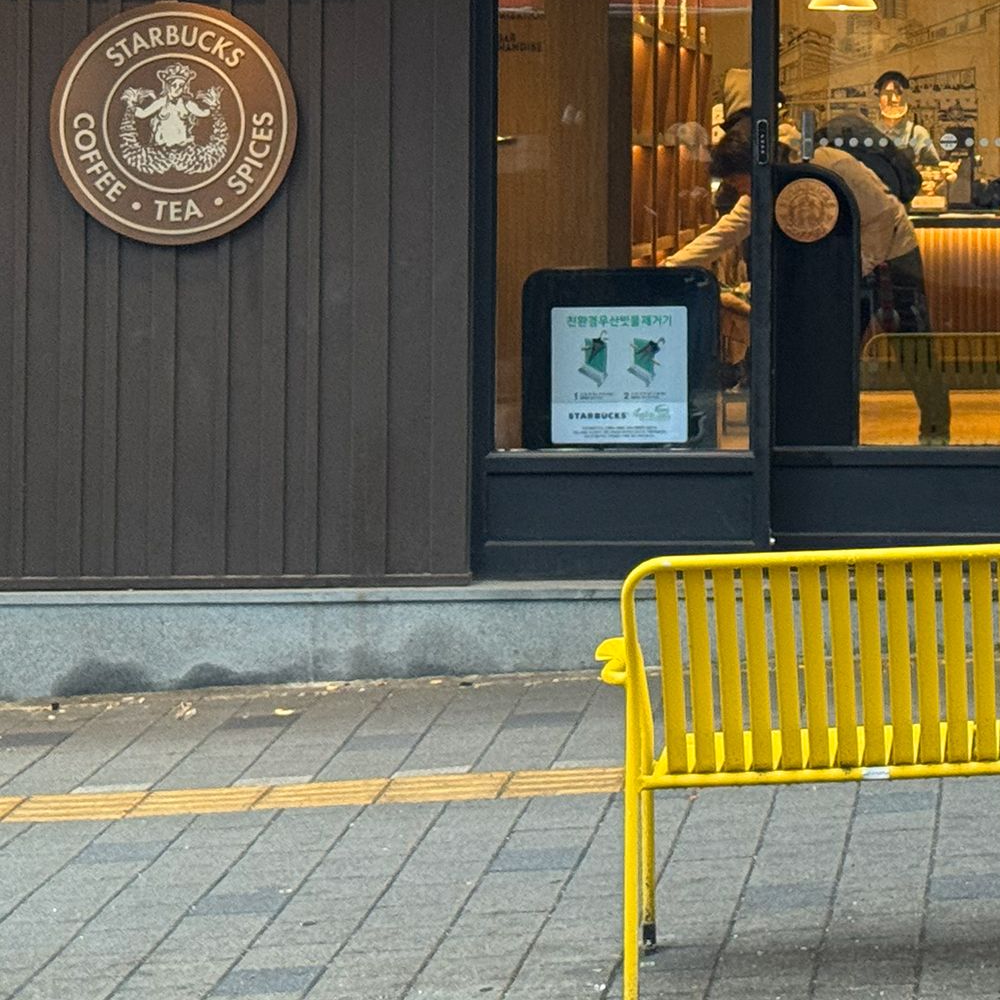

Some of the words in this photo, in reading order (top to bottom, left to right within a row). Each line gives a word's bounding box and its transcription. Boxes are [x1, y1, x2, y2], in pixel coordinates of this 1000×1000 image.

[106, 24, 246, 68] STARBUCKS
[73, 112, 127, 202] COFFEE
[154, 199, 204, 222] TEA
[227, 111, 274, 195] SPICES
